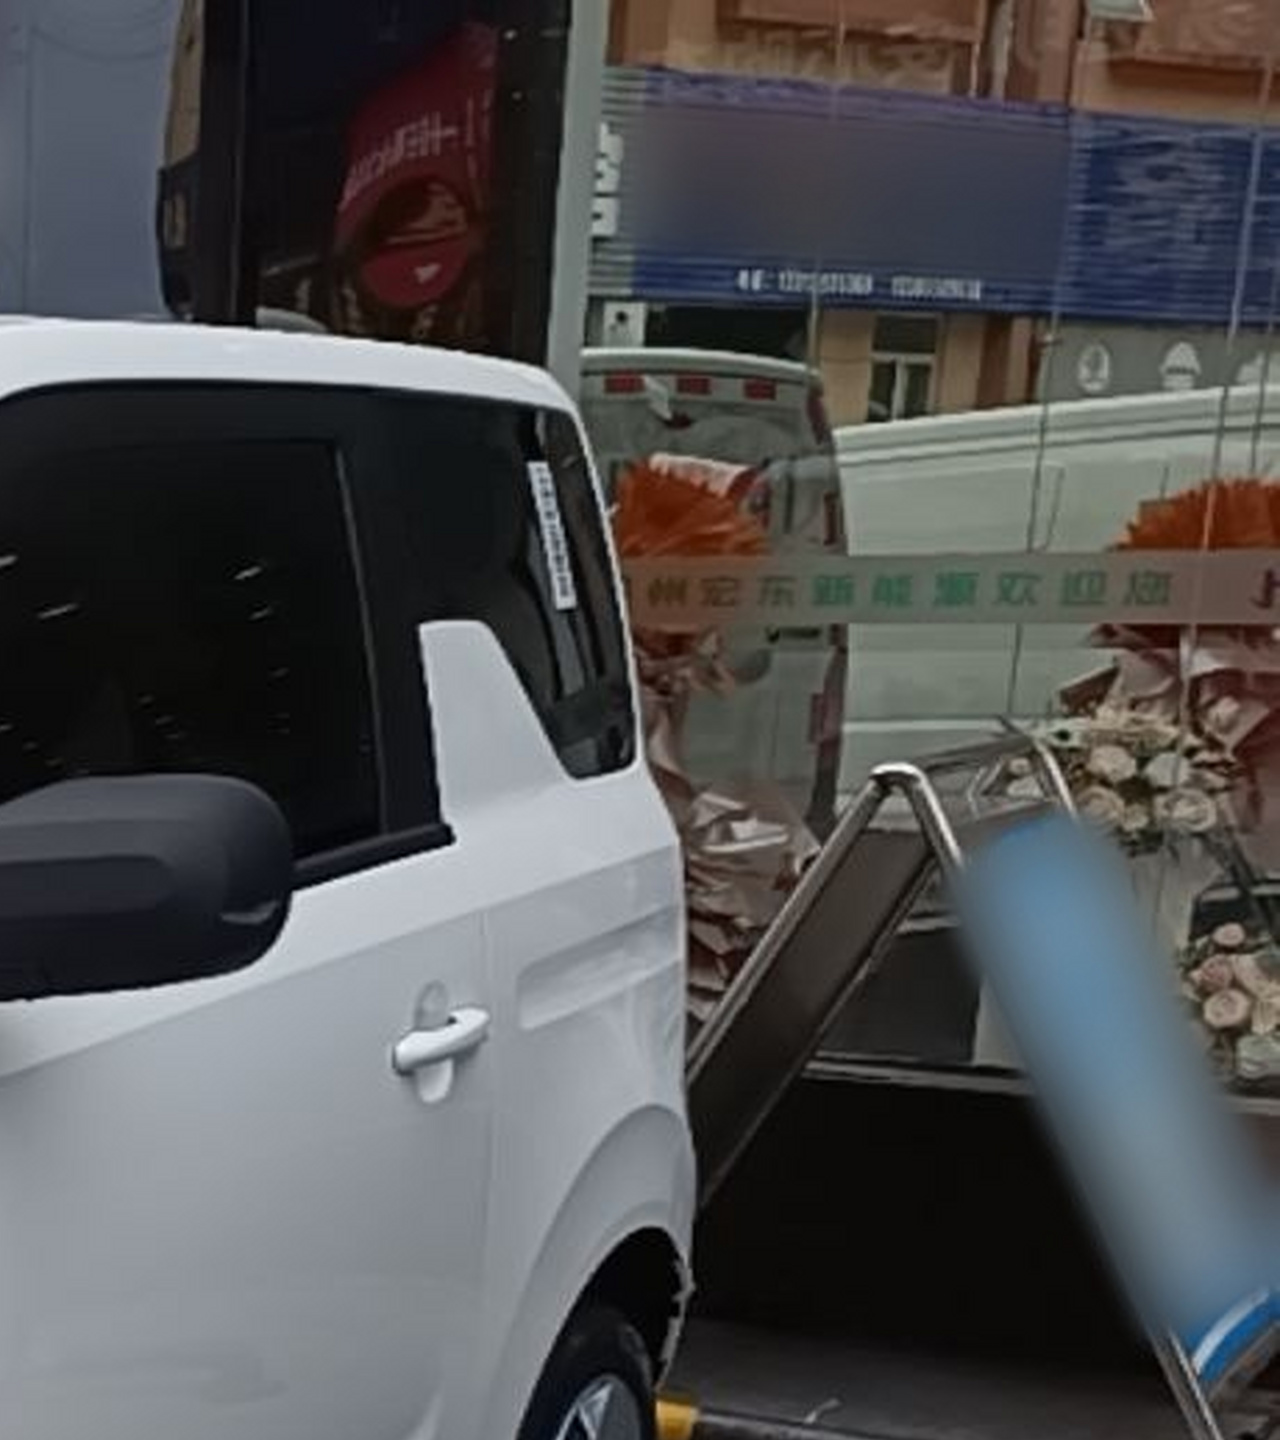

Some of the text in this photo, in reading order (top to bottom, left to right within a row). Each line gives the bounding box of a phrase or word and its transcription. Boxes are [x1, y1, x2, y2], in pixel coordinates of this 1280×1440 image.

[626, 568, 1174, 609] 州宏东新能源欢迎您
